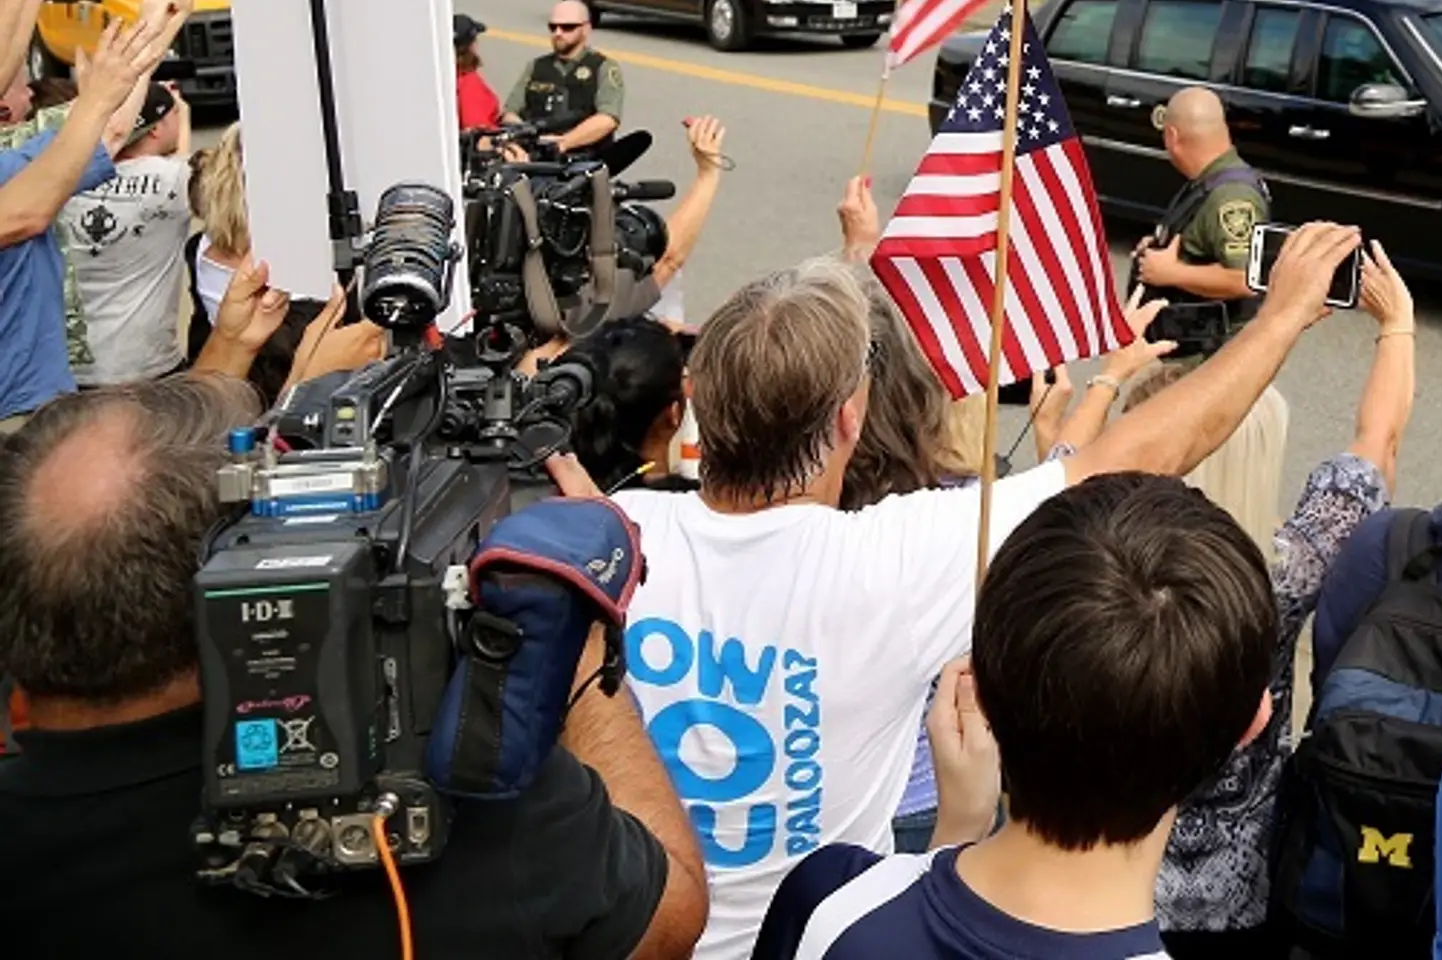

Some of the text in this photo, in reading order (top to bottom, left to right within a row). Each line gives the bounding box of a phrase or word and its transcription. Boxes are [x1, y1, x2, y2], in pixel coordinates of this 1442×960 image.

[624, 617, 777, 705] OW
[783, 648, 824, 857] PALOOZA?
[1358, 824, 1414, 869] M
